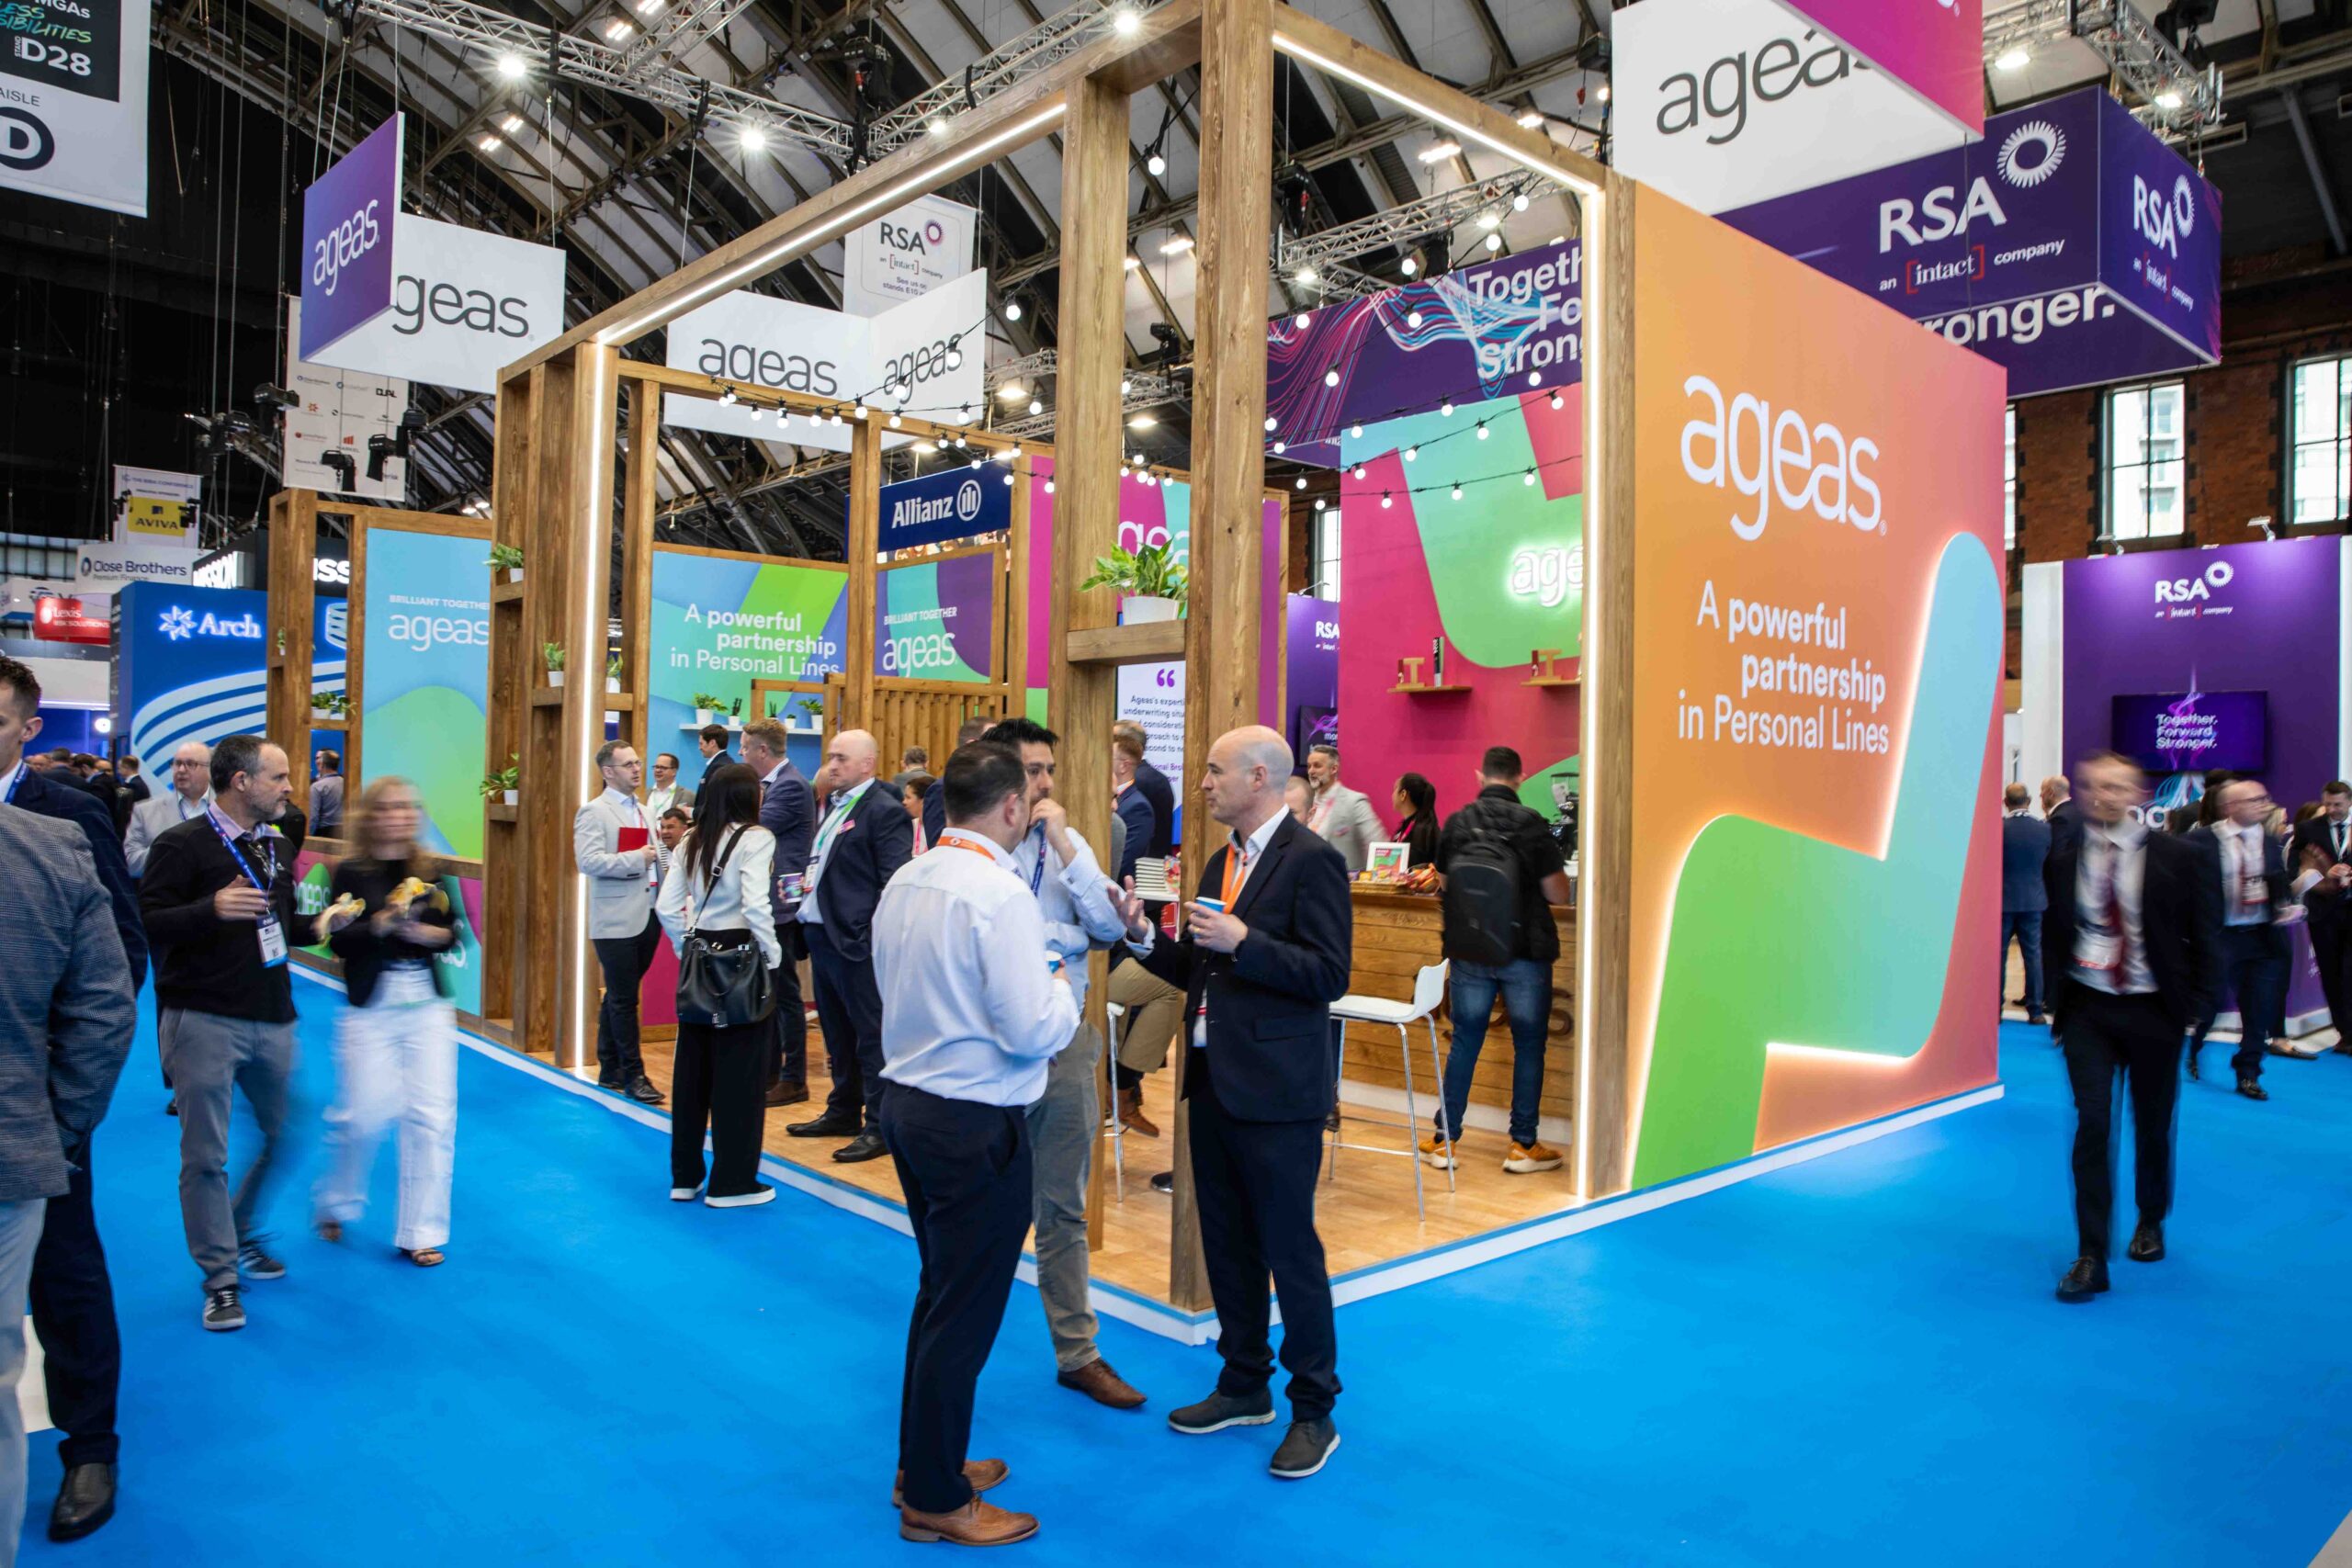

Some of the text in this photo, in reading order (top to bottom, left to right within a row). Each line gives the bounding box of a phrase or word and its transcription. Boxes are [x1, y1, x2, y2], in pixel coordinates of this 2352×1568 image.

[22, 37, 91, 76] D28
[1657, 28, 1871, 144] agea
[1879, 175, 2007, 254] RSA
[2133, 175, 2177, 260] RSA
[313, 199, 379, 296] ageas
[880, 221, 926, 256] RSA
[1468, 245, 1583, 307] Togeth
[1879, 277, 1897, 291] an
[1994, 239, 2065, 265] company
[1539, 292, 1583, 333] Fo
[698, 338, 838, 396] ageas
[884, 333, 962, 404] ageas
[1477, 333, 1583, 379] Stron
[136, 517, 178, 530] AVIVA
[891, 496, 954, 529] Allianz
[94, 560, 187, 576] Close Brothers
[1512, 545, 1583, 607] age
[389, 594, 440, 606] BRILLIANT
[2154, 578, 2211, 604] RSA
[198, 613, 262, 638] Arch
[388, 614, 490, 652] ageas
[684, 604, 801, 632] A powerful
[920, 606, 957, 621] TOGETHER
[1316, 620, 1340, 640] RSA
[1697, 580, 1846, 649] A powerful
[671, 647, 840, 676] in Personal Lines
[717, 632, 837, 659] partnership
[882, 632, 956, 678] ageas
[1741, 653, 1886, 713] partnership
[1679, 689, 1889, 754] in Personal Lines
